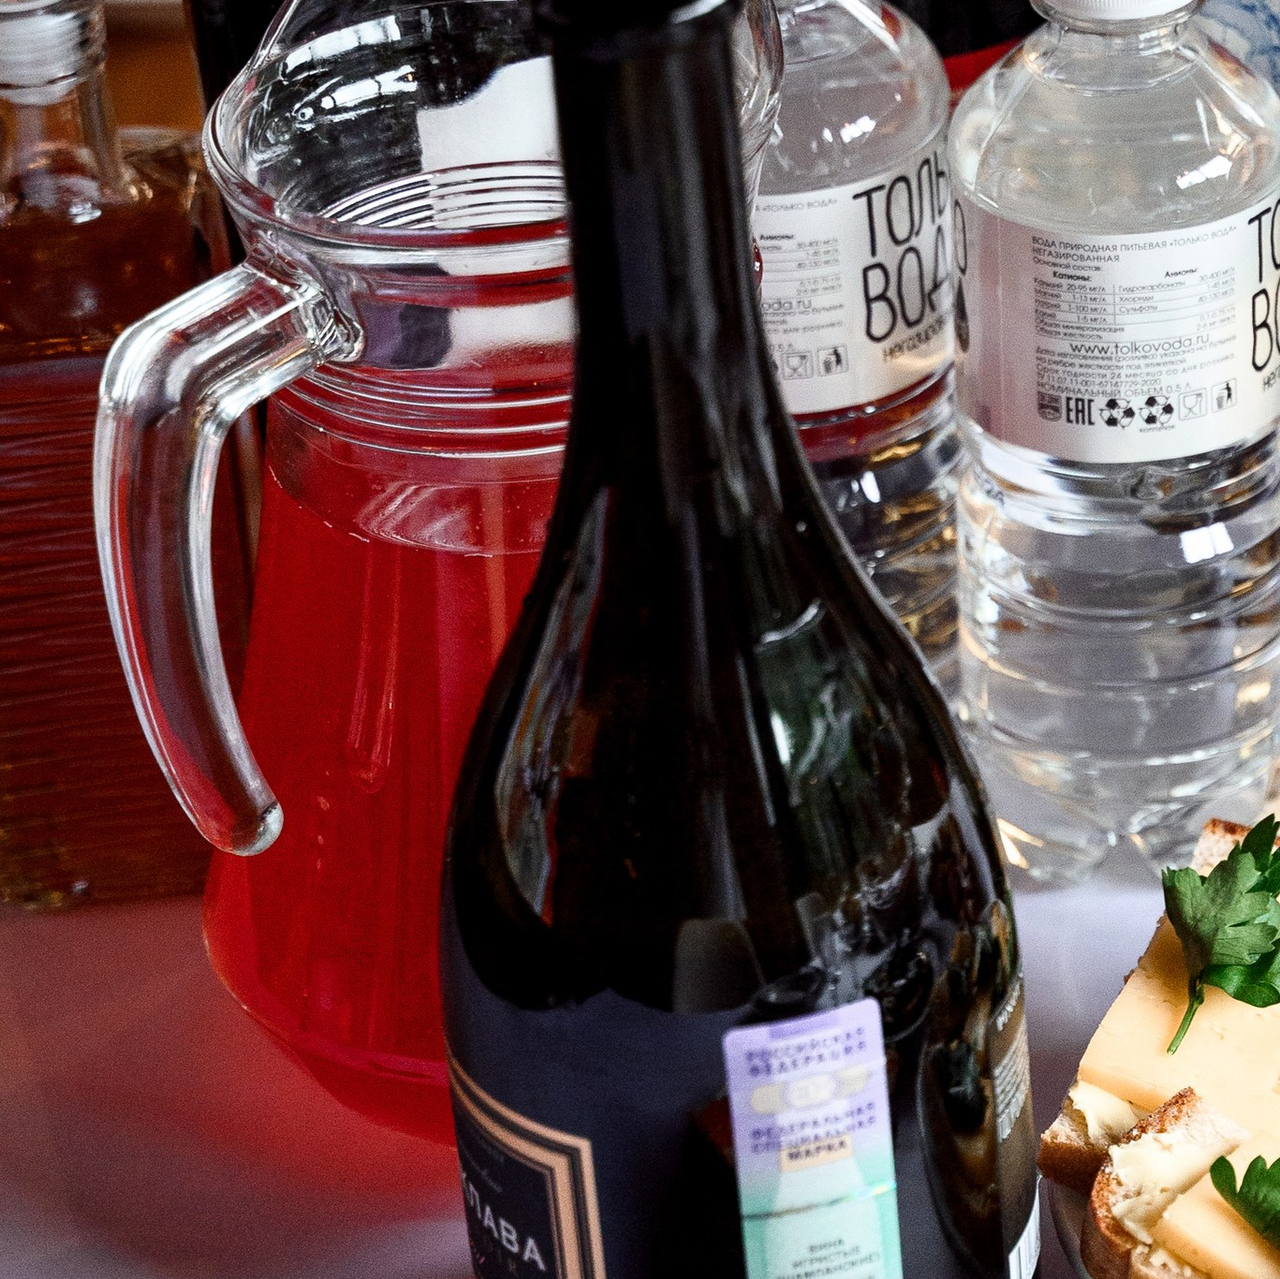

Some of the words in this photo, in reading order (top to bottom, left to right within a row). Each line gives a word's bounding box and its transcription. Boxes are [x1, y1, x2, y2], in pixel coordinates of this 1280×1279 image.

[852, 150, 949, 258] ТОЛЬ
[1032, 236, 1056, 249] ВОДА
[1059, 240, 1118, 253] ПРИРОДНАЯ
[1120, 241, 1167, 252] ПИТЬЕВАЯ
[1032, 247, 1120, 263] НЕГАЗИРОВАННАЯ
[1052, 271, 1092, 282] Катионы:
[1164, 267, 1198, 279] Анионы:
[1069, 334, 1210, 356] www.tolkovoda.ru
[1037, 381, 1122, 398] НОМИНАЛЬНЫЙ
[787, 1140, 847, 1161] МАРКА
